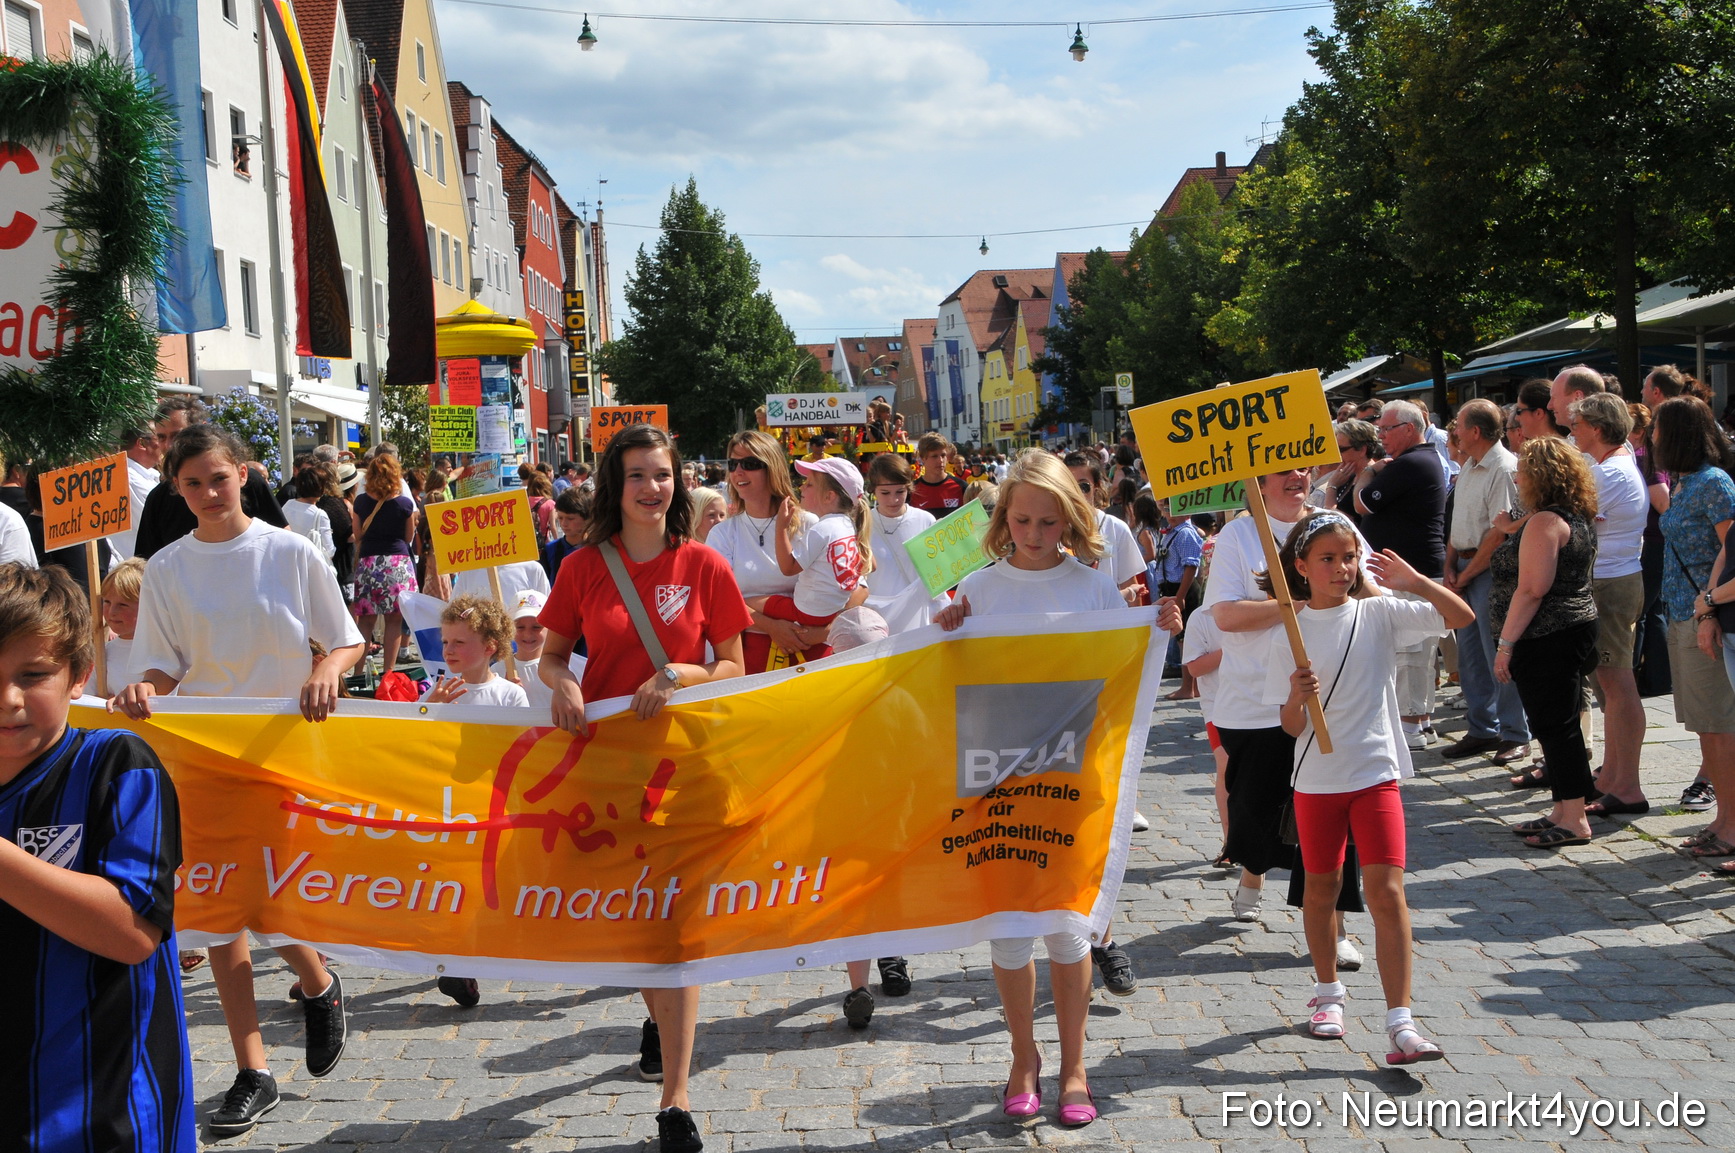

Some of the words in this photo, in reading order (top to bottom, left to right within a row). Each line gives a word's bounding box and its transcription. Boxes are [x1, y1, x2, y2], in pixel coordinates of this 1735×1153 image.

[565, 292, 588, 394] HOTEL
[598, 410, 656, 427] SPORT
[784, 410, 841, 421] HANDBALL
[1167, 385, 1290, 443] SPORT
[1165, 440, 1234, 486] macht
[1247, 423, 1327, 467] Freude
[53, 463, 116, 505] SPORT
[1177, 485, 1213, 512] gibt
[49, 506, 83, 539] macht
[440, 498, 517, 536] SPORT
[923, 511, 975, 559] SPORT
[447, 530, 517, 565] verbindet
[941, 821, 1075, 854] gesundheitliche
[965, 843, 1049, 869] Aufklärung
[262, 846, 466, 915] Verein
[513, 865, 683, 922] macht
[705, 855, 833, 917] mit!
